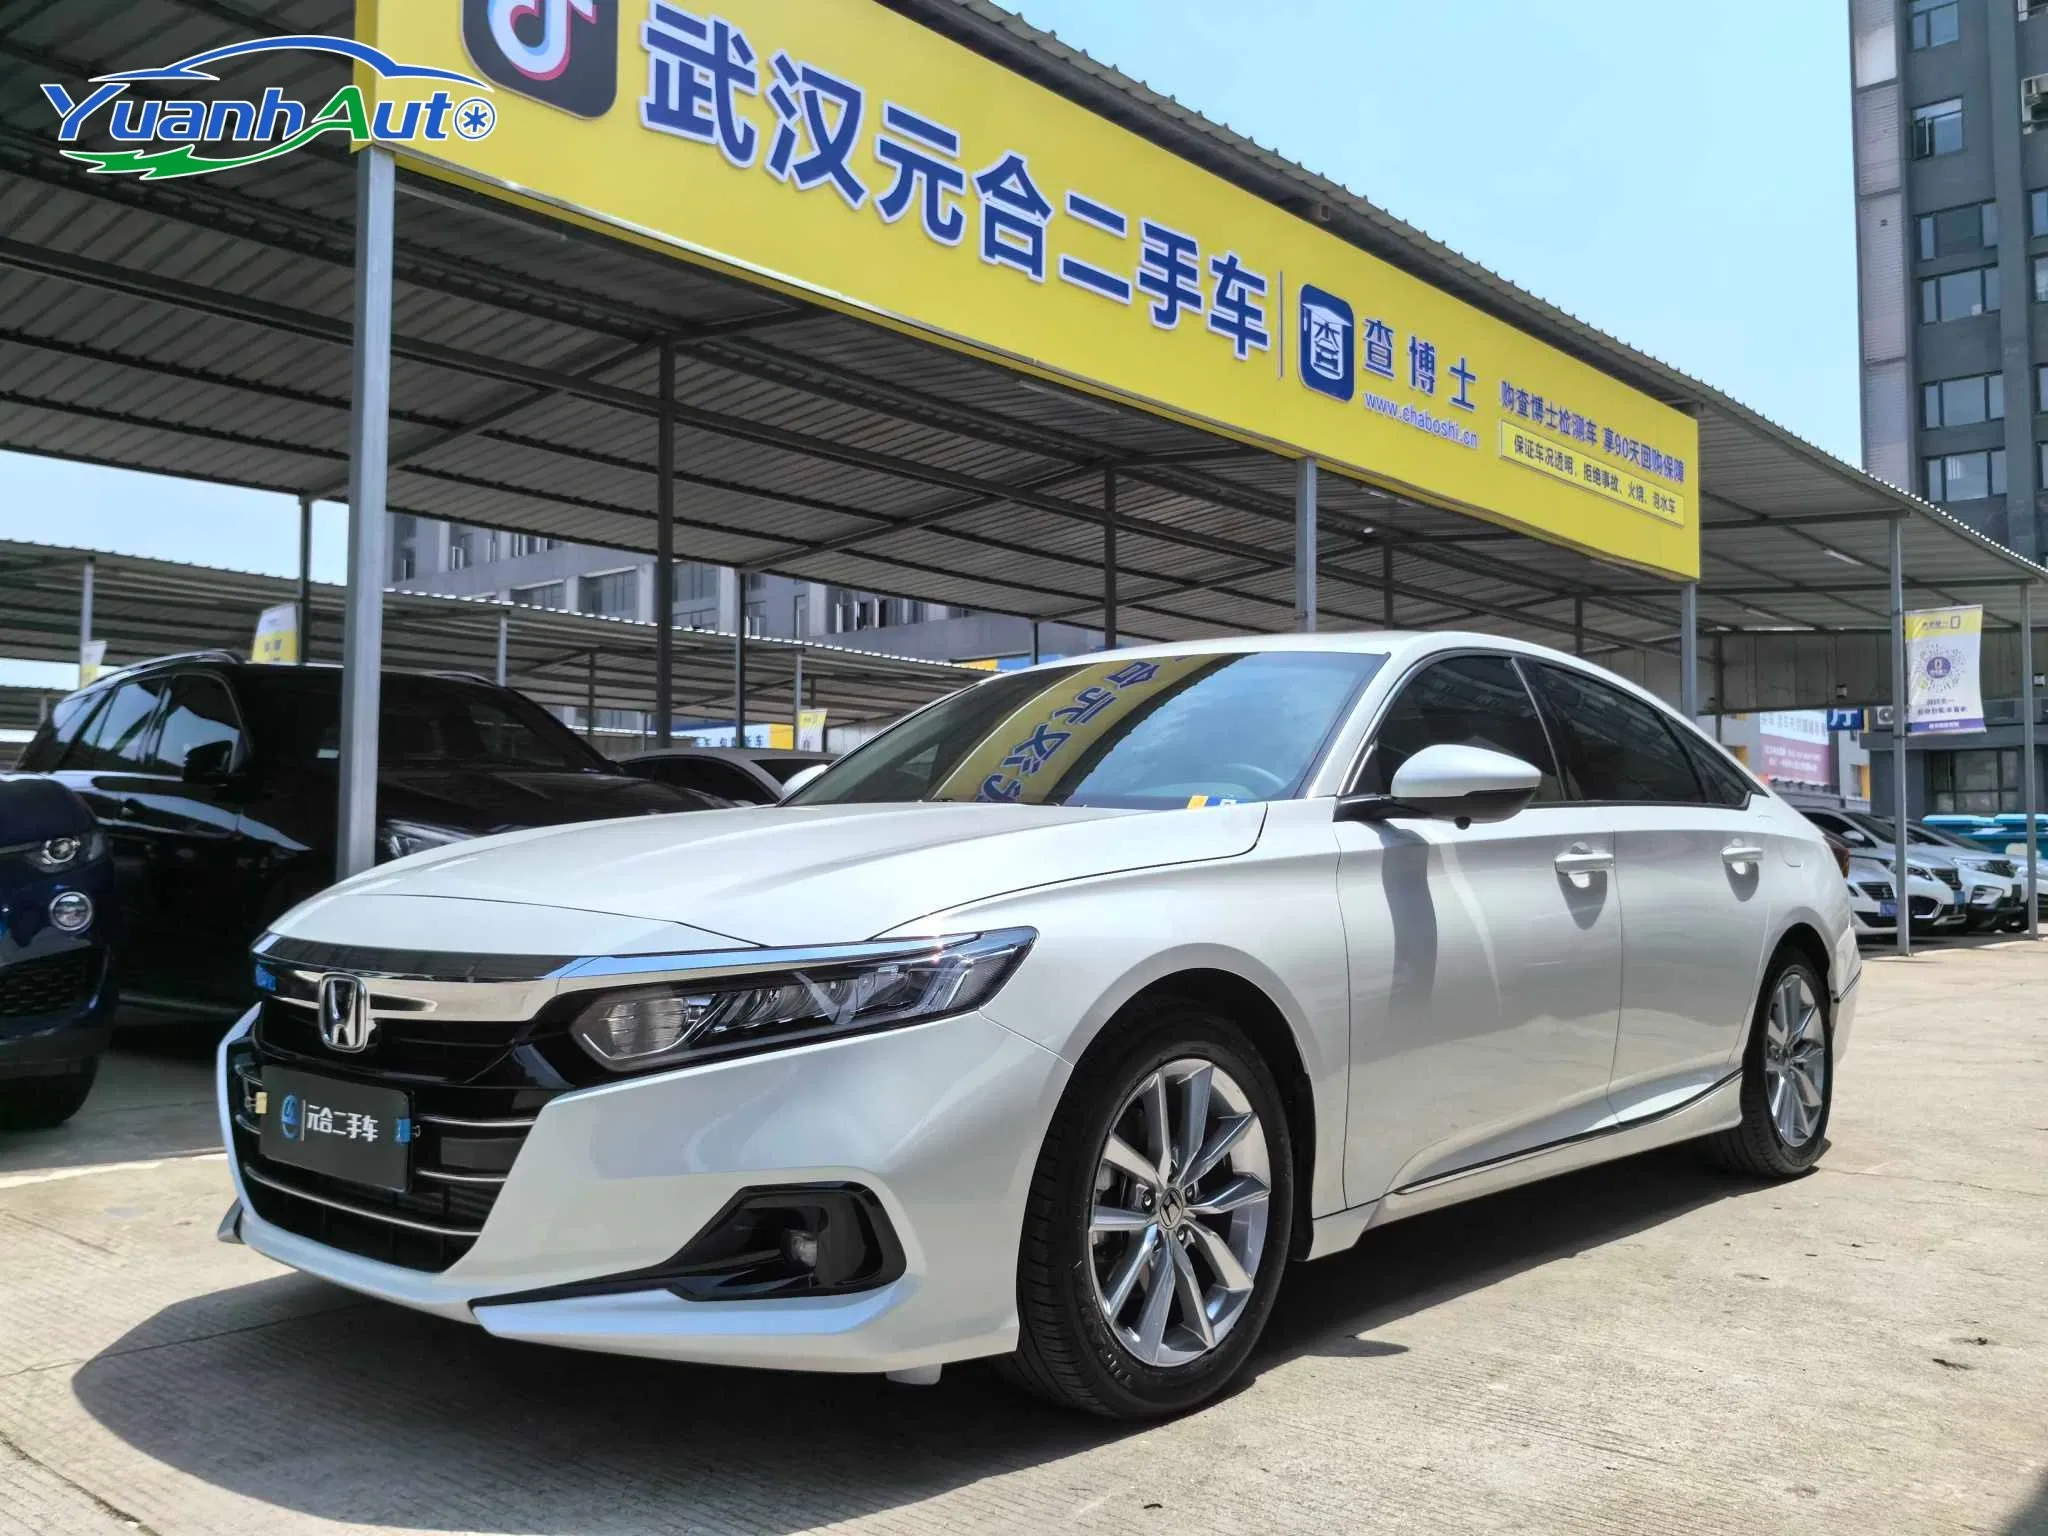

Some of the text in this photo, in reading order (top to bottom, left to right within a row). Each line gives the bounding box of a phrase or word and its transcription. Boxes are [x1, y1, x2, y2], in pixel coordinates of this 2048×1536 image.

[641, 2, 1270, 360] 武汉元合二手车
[1363, 318, 1478, 413] 查博士
[1364, 391, 1480, 449] www.chaboshi.cn
[306, 1103, 379, 1142] 元合二手车
